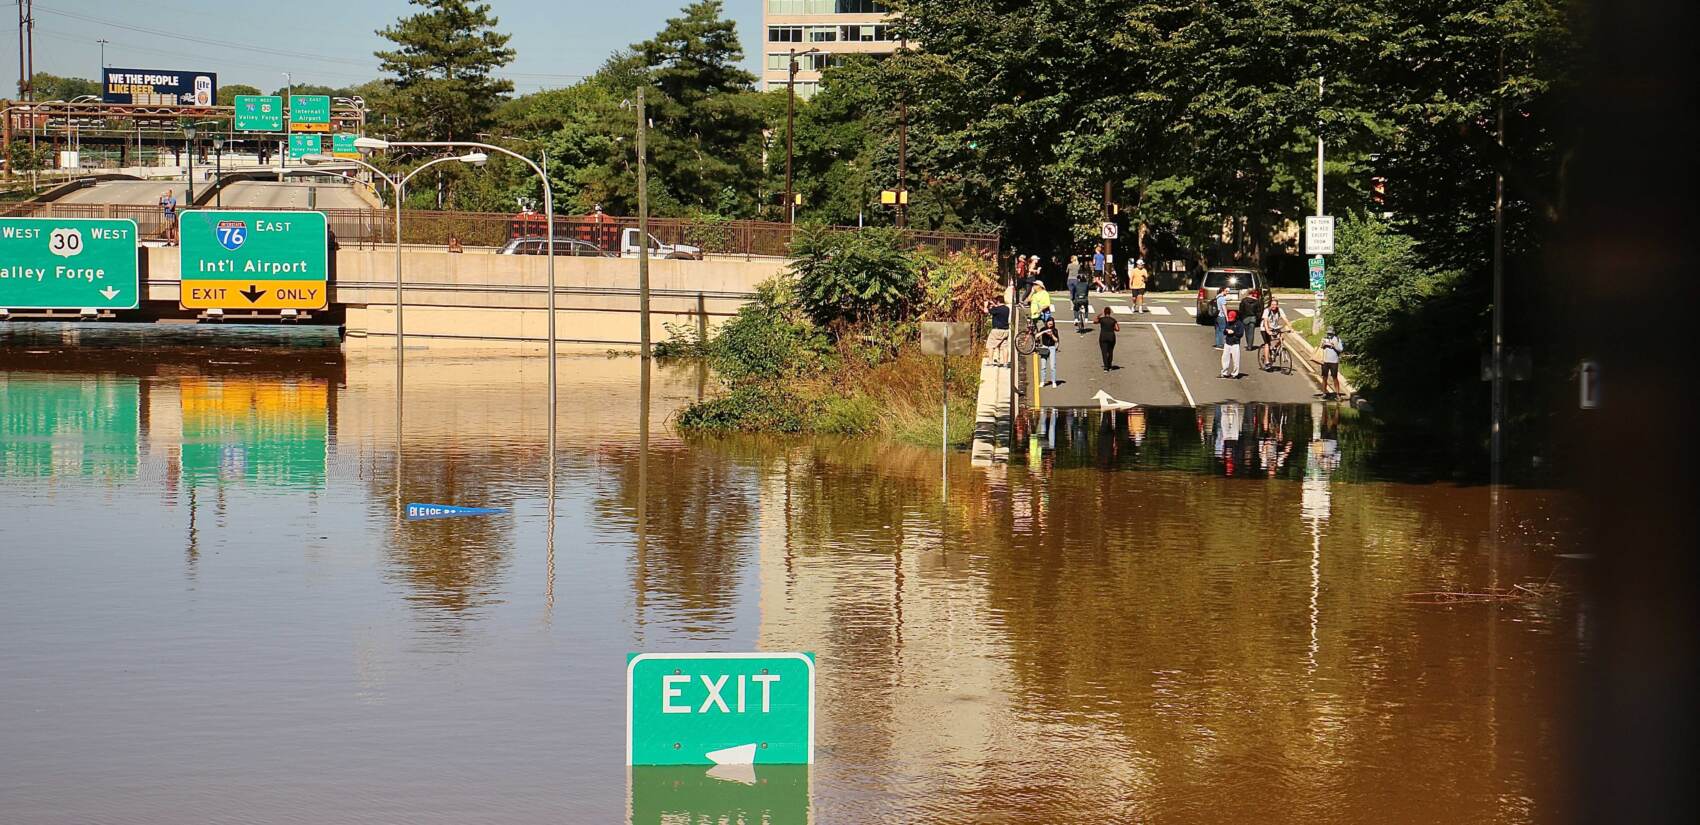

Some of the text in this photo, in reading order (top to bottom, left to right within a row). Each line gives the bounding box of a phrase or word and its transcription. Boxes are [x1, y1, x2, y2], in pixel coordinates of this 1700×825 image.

[108, 73, 179, 86] WE THE PEOPLE
[108, 83, 130, 94] LIKE
[2, 226, 128, 250] WEST 30 WEST
[219, 220, 292, 245] 76 EAST
[0, 265, 105, 283] alley Forge
[199, 259, 307, 275] Int'l Airport
[192, 288, 317, 300] EXIT ONLY
[662, 674, 781, 714] EXIT
